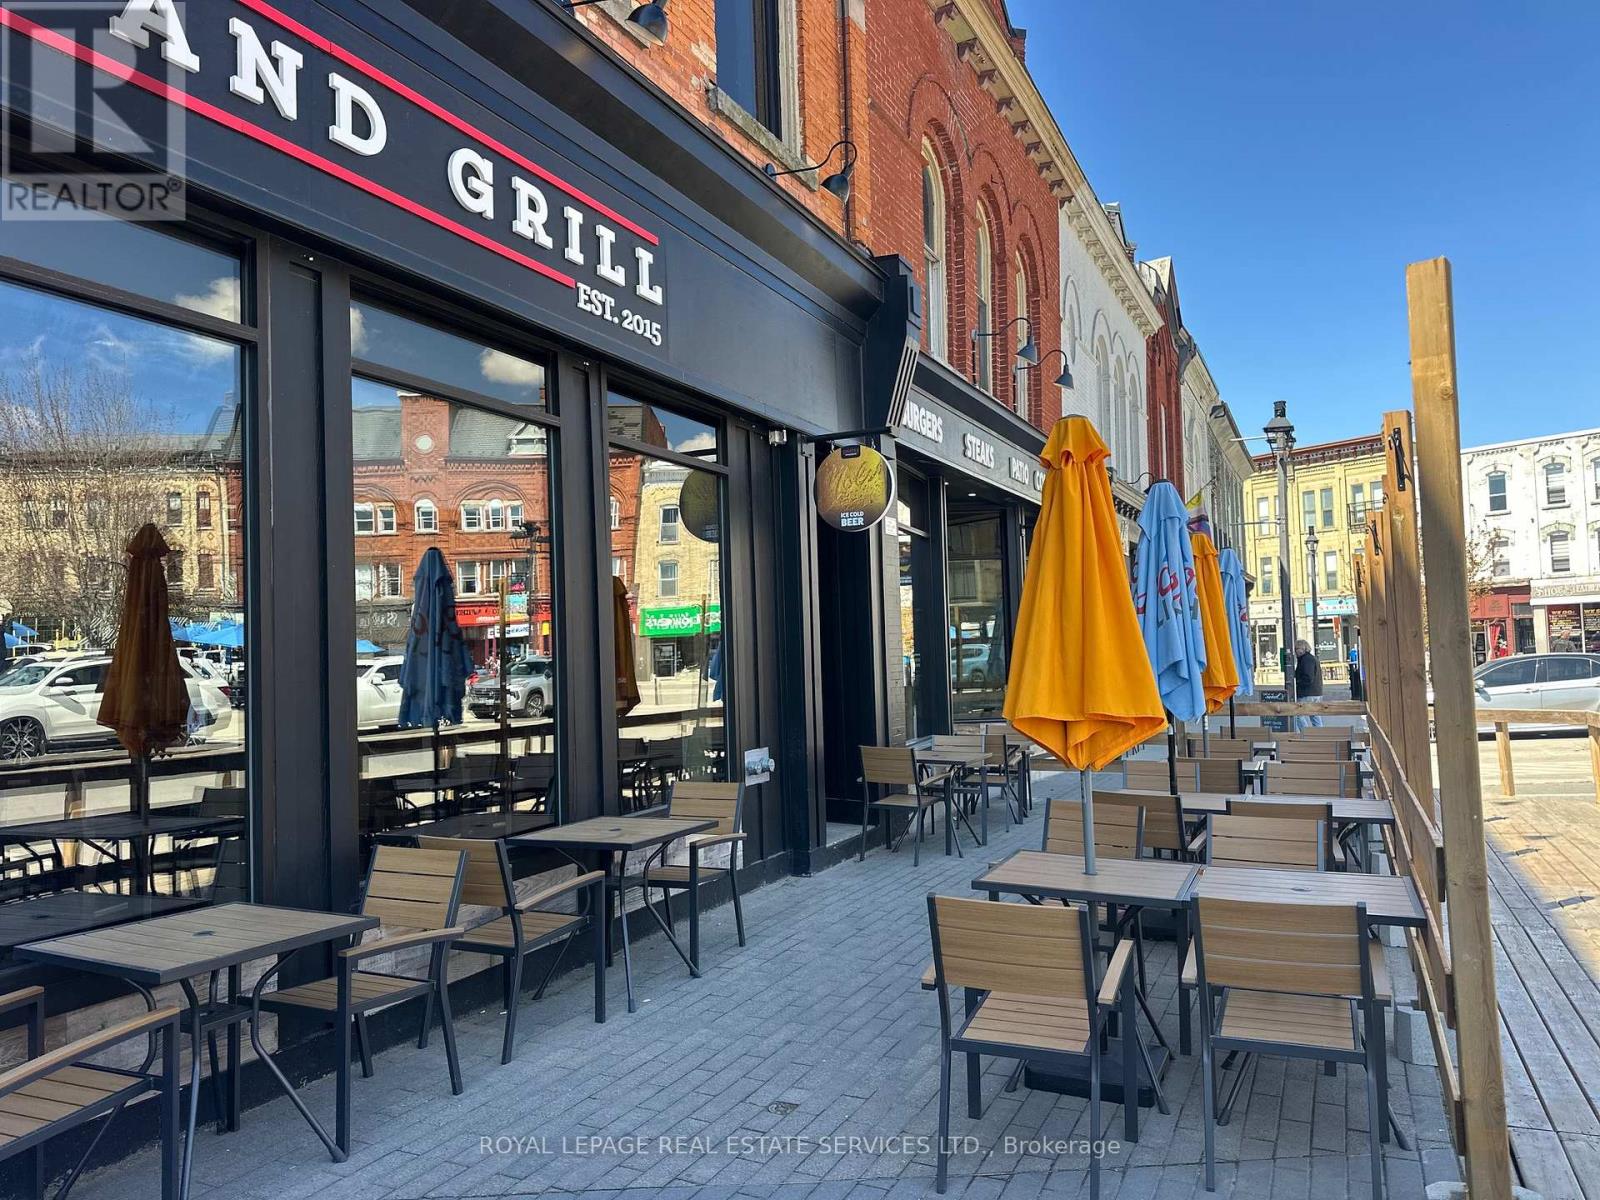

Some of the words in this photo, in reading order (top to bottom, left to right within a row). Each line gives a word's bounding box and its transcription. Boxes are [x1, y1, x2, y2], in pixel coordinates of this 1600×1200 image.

[109, 0, 387, 157] AND
[447, 146, 664, 306] GRILL
[576, 281, 619, 324] EST.
[621, 308, 662, 346] 2015
[965, 432, 995, 469] STEAKS
[1010, 456, 1029, 485] PATIO
[840, 517, 865, 527] BEER
